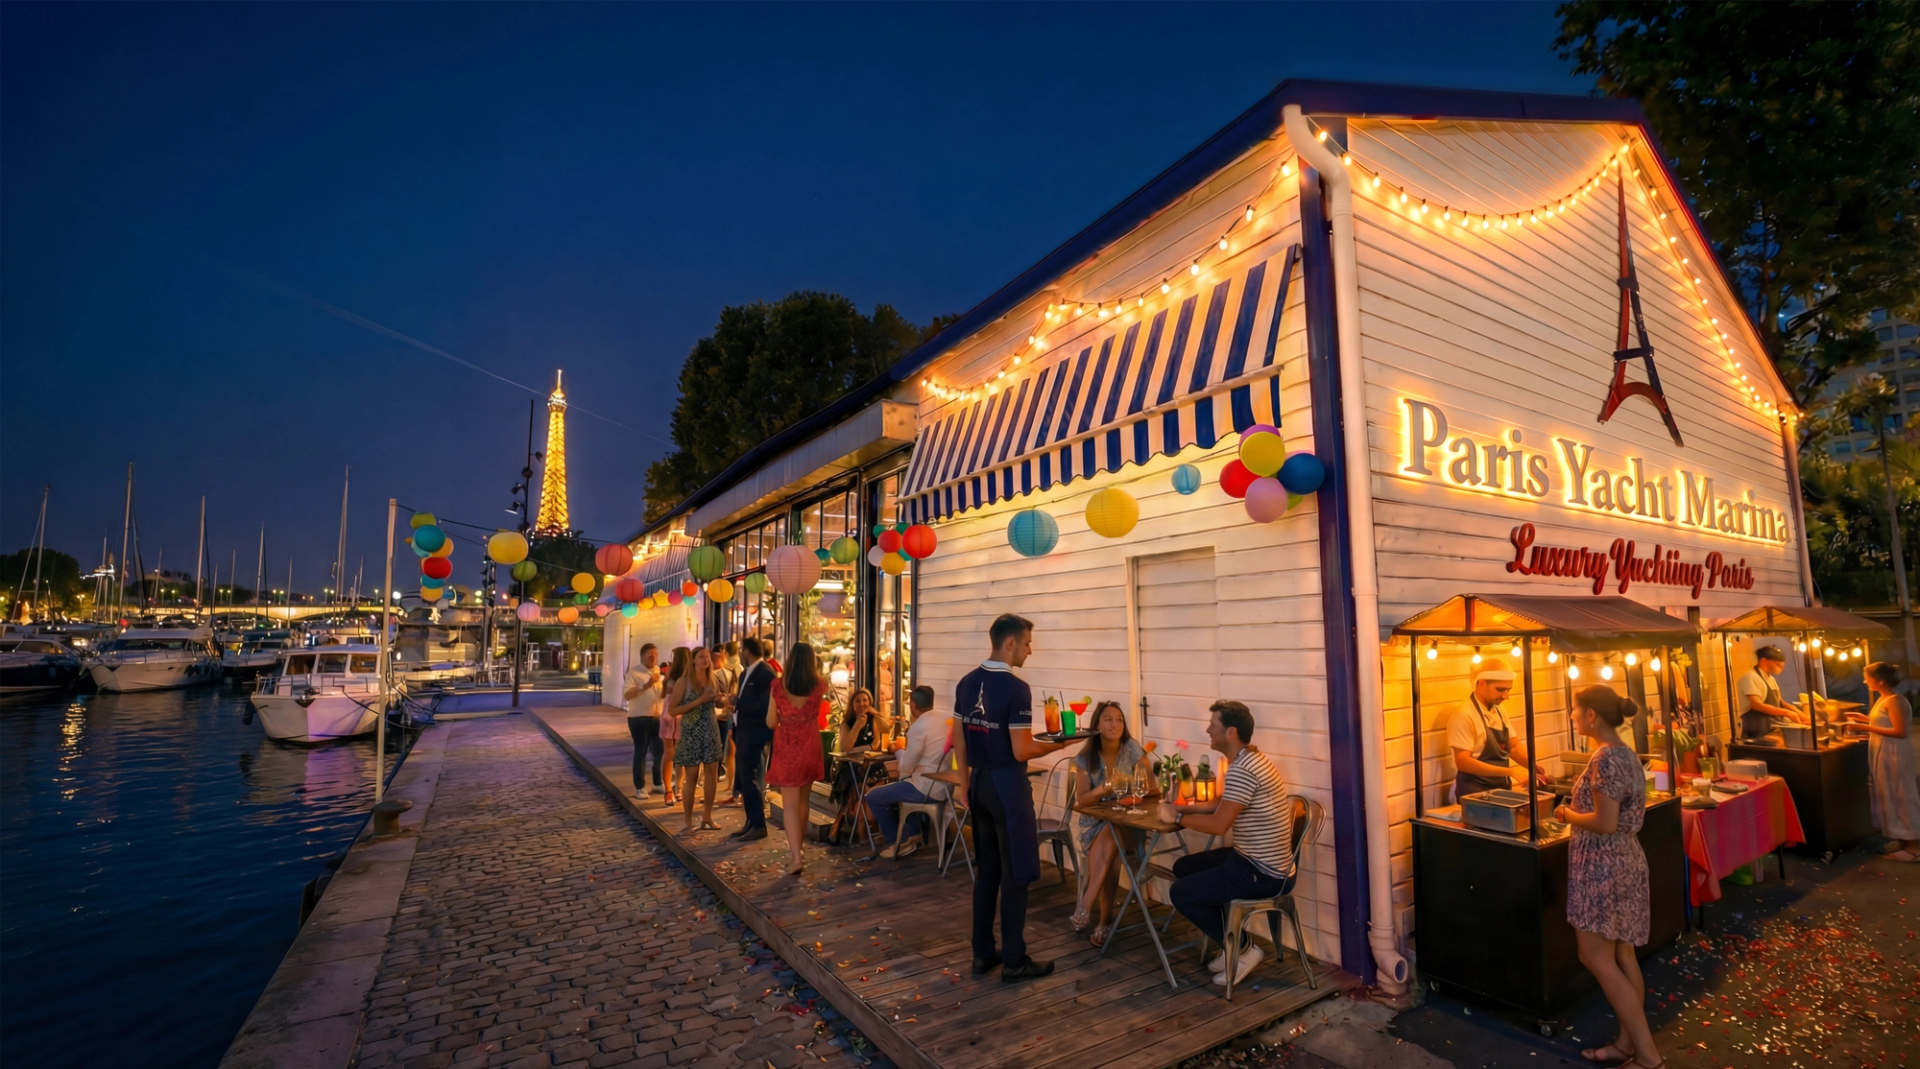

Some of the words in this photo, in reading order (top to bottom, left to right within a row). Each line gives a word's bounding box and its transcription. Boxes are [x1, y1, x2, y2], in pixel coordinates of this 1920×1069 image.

[1403, 398, 1550, 497] Paris
[1556, 437, 1675, 522] Yacht
[1680, 470, 1792, 543] Marina
[1506, 522, 1609, 595] Luxury
[1705, 551, 1754, 590] Paris
